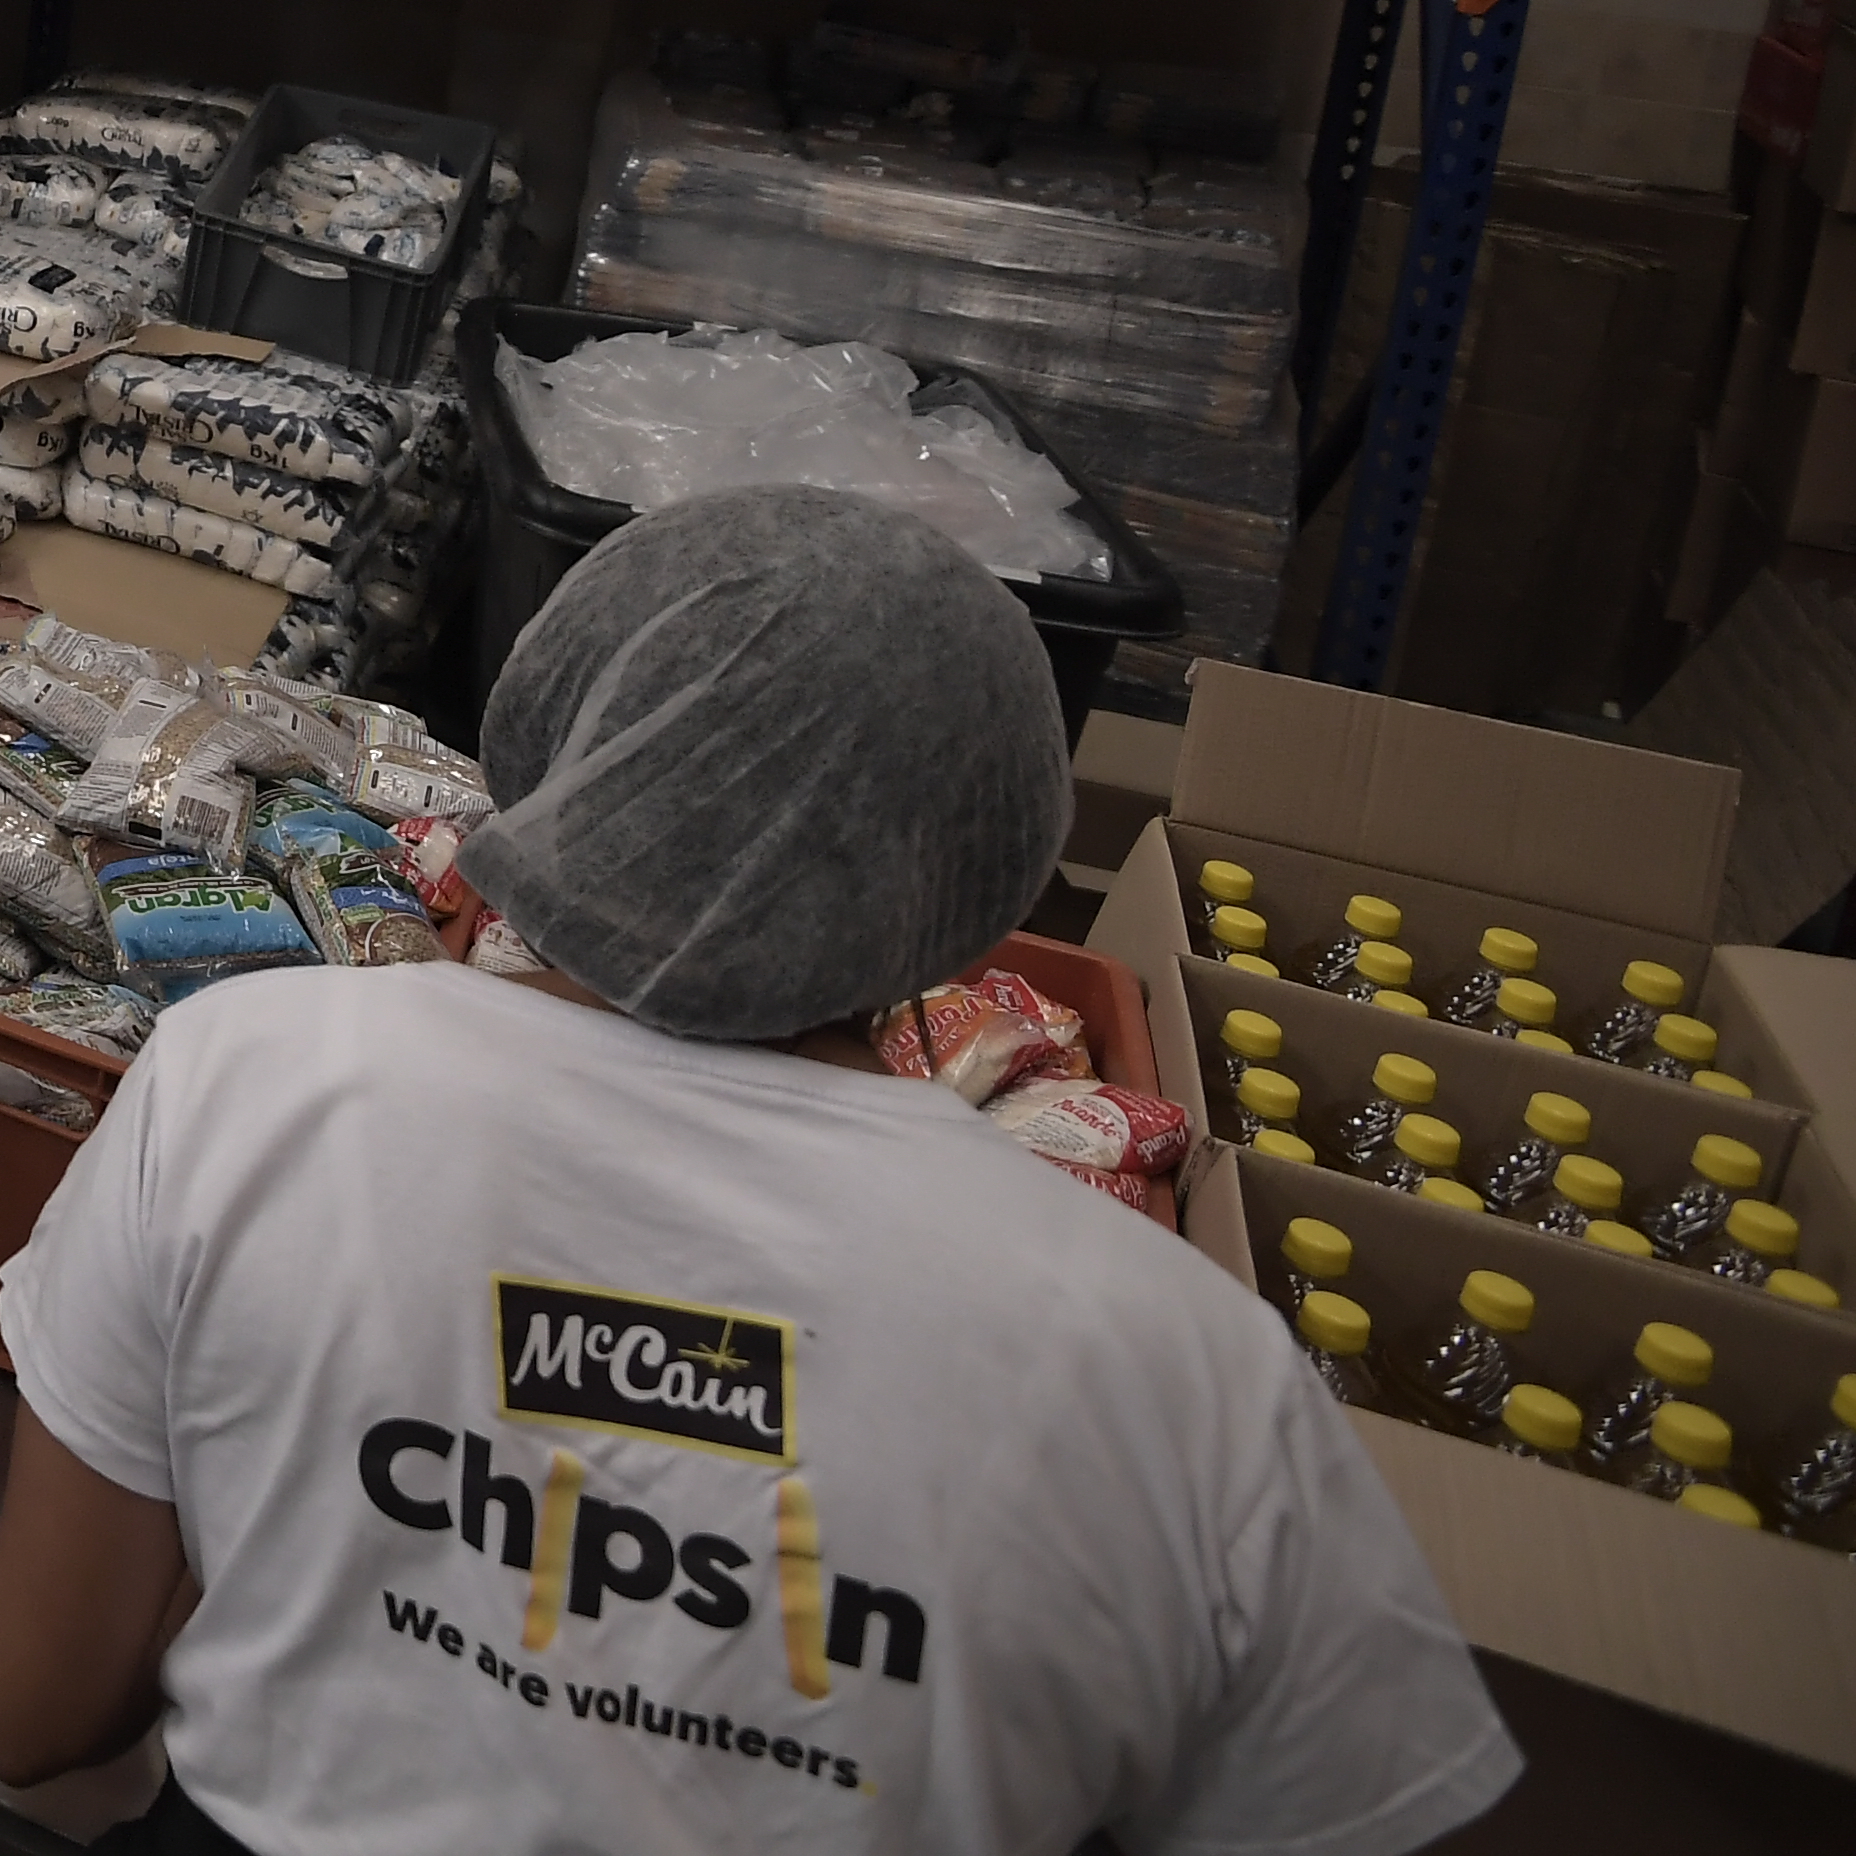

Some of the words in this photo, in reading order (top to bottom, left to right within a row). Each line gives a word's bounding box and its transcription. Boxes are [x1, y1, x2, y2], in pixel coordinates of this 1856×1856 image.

[511, 1311, 784, 1437] McCain
[383, 1590, 465, 1657] We
[478, 1642, 548, 1707] are
